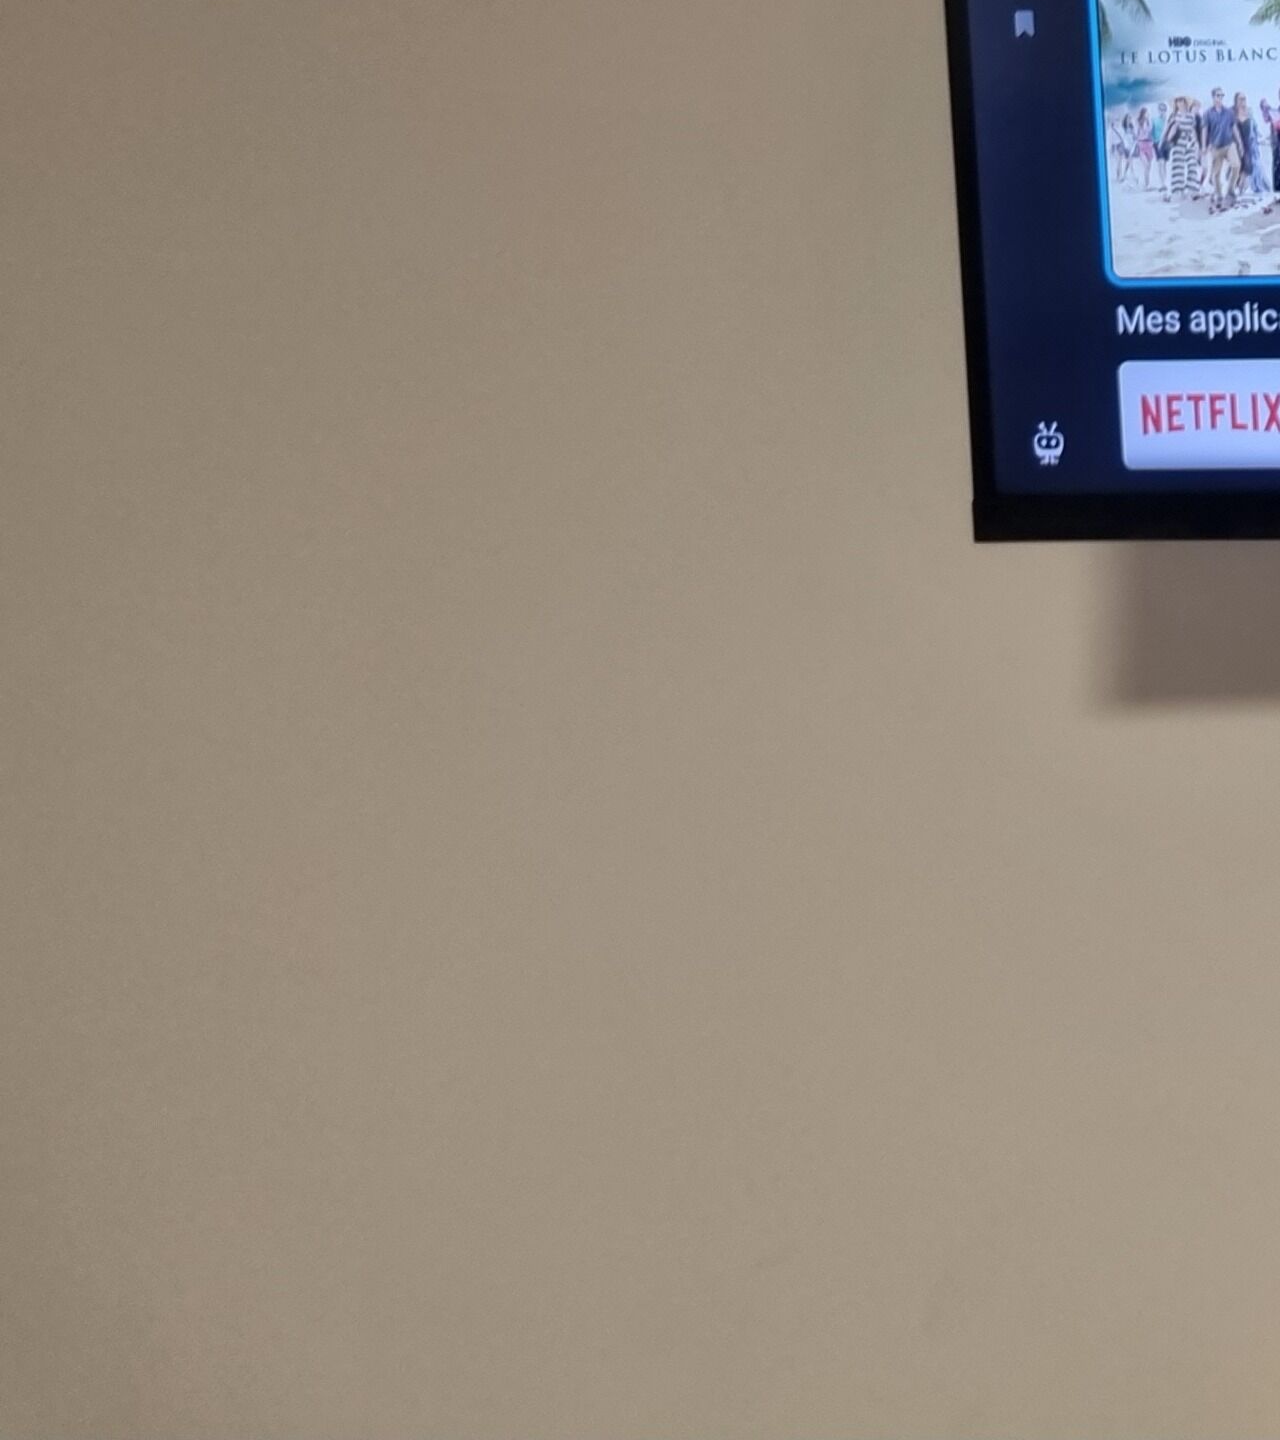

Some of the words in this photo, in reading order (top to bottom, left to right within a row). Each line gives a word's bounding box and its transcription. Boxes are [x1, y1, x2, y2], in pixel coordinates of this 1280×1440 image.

[1168, 35, 1192, 48] HBO
[1149, 49, 1208, 64] LOTUS
[1216, 47, 1279, 62] BLANC
[1116, 305, 1180, 335] Mes
